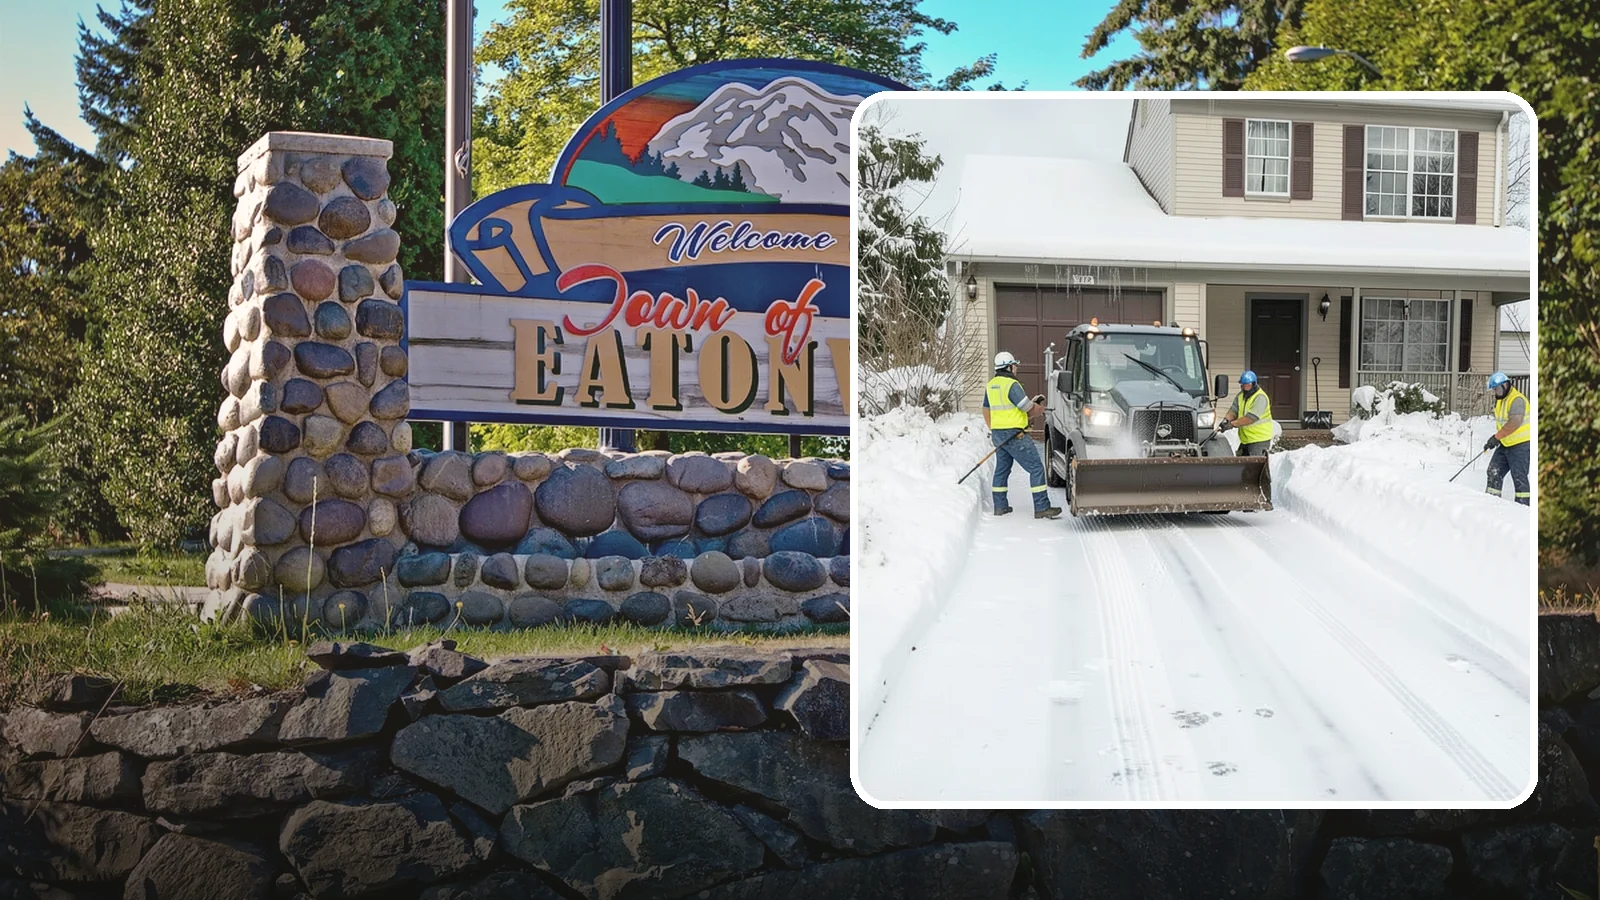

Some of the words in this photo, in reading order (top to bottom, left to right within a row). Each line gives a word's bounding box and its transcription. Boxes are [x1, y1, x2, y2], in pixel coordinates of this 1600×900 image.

[653, 220, 837, 263] Welcome
[557, 264, 737, 336] Town
[765, 279, 826, 365] of
